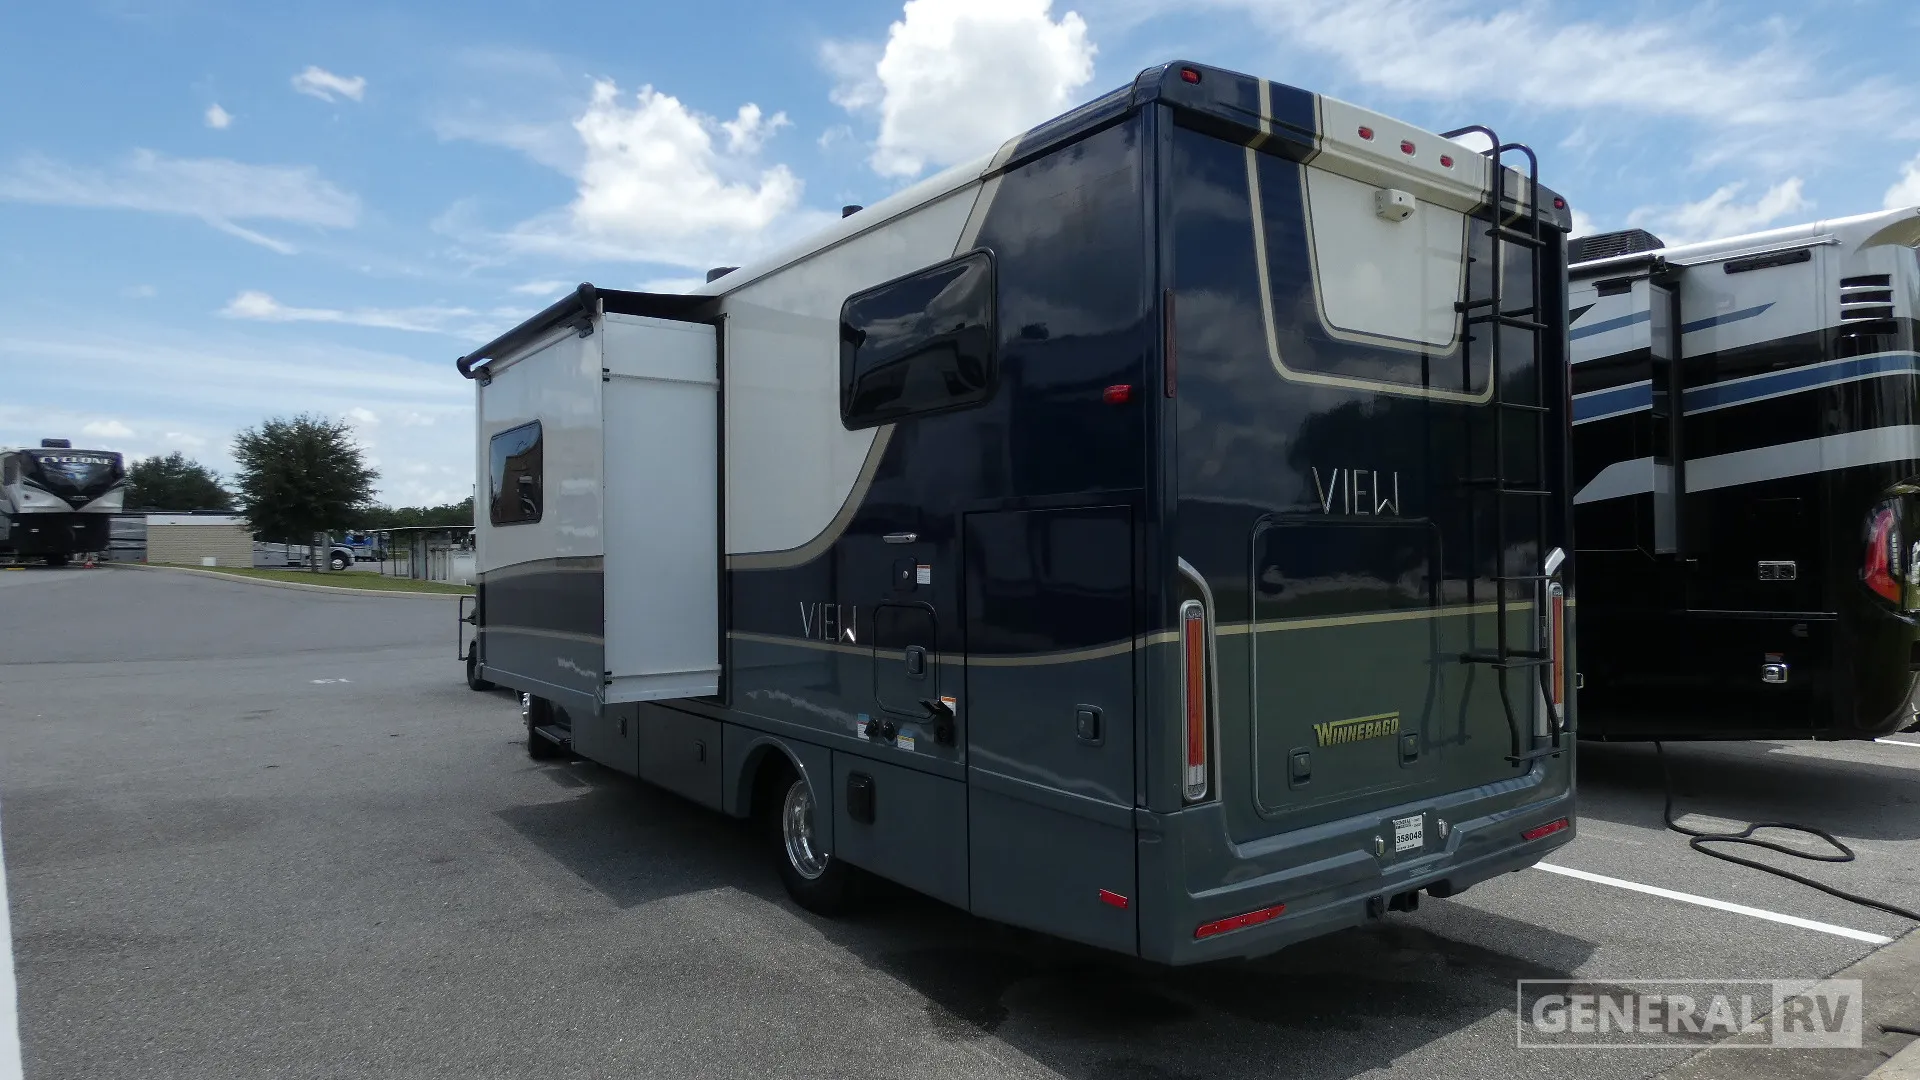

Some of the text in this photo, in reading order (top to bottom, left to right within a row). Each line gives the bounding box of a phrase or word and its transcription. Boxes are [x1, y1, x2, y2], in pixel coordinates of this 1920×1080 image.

[1312, 467, 1399, 515] VIEW
[800, 601, 857, 644] VIEW
[1313, 711, 1400, 747] WINNEBAGO
[1396, 830, 1422, 844] 358048
